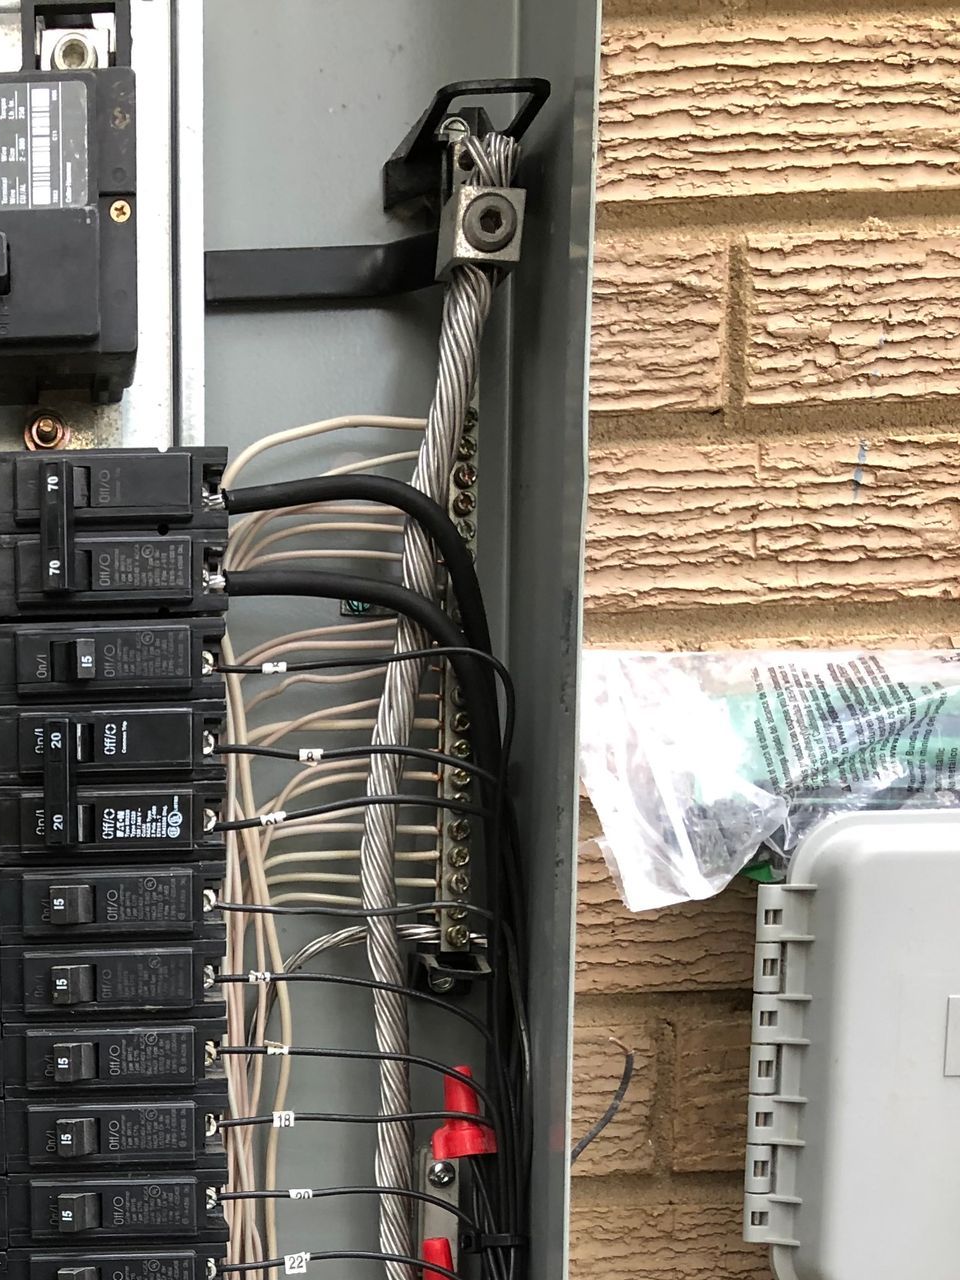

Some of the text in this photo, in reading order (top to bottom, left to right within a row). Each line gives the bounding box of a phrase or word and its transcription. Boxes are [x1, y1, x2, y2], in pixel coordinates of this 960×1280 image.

[47, 475, 59, 492] 70
[49, 559, 61, 576] 70
[81, 655, 93, 668] 15
[51, 732, 62, 749] 20
[52, 814, 64, 831] 20
[53, 898, 65, 910] 15
[56, 978, 68, 990] 15
[58, 1057, 69, 1069] 15
[277, 1113, 291, 1128] 18
[60, 1133, 72, 1145] 15
[62, 1209, 73, 1222] 15
[288, 1255, 304, 1270] 22
